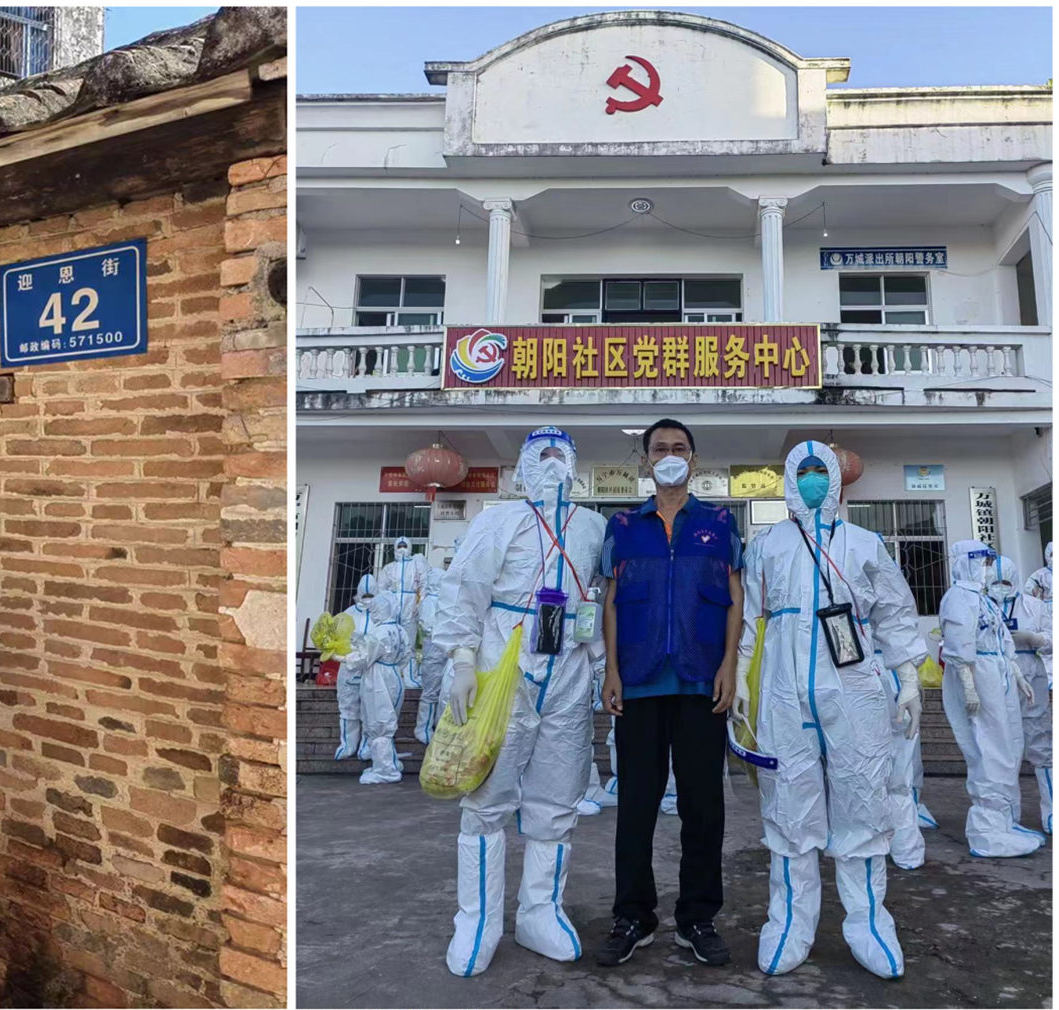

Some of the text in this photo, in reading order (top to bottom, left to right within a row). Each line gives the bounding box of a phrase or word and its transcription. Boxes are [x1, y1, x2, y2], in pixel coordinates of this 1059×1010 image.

[17, 257, 120, 292] 迎恩街
[39, 287, 100, 335] 42
[511, 335, 810, 380] 朝阳社区党群服务中心
